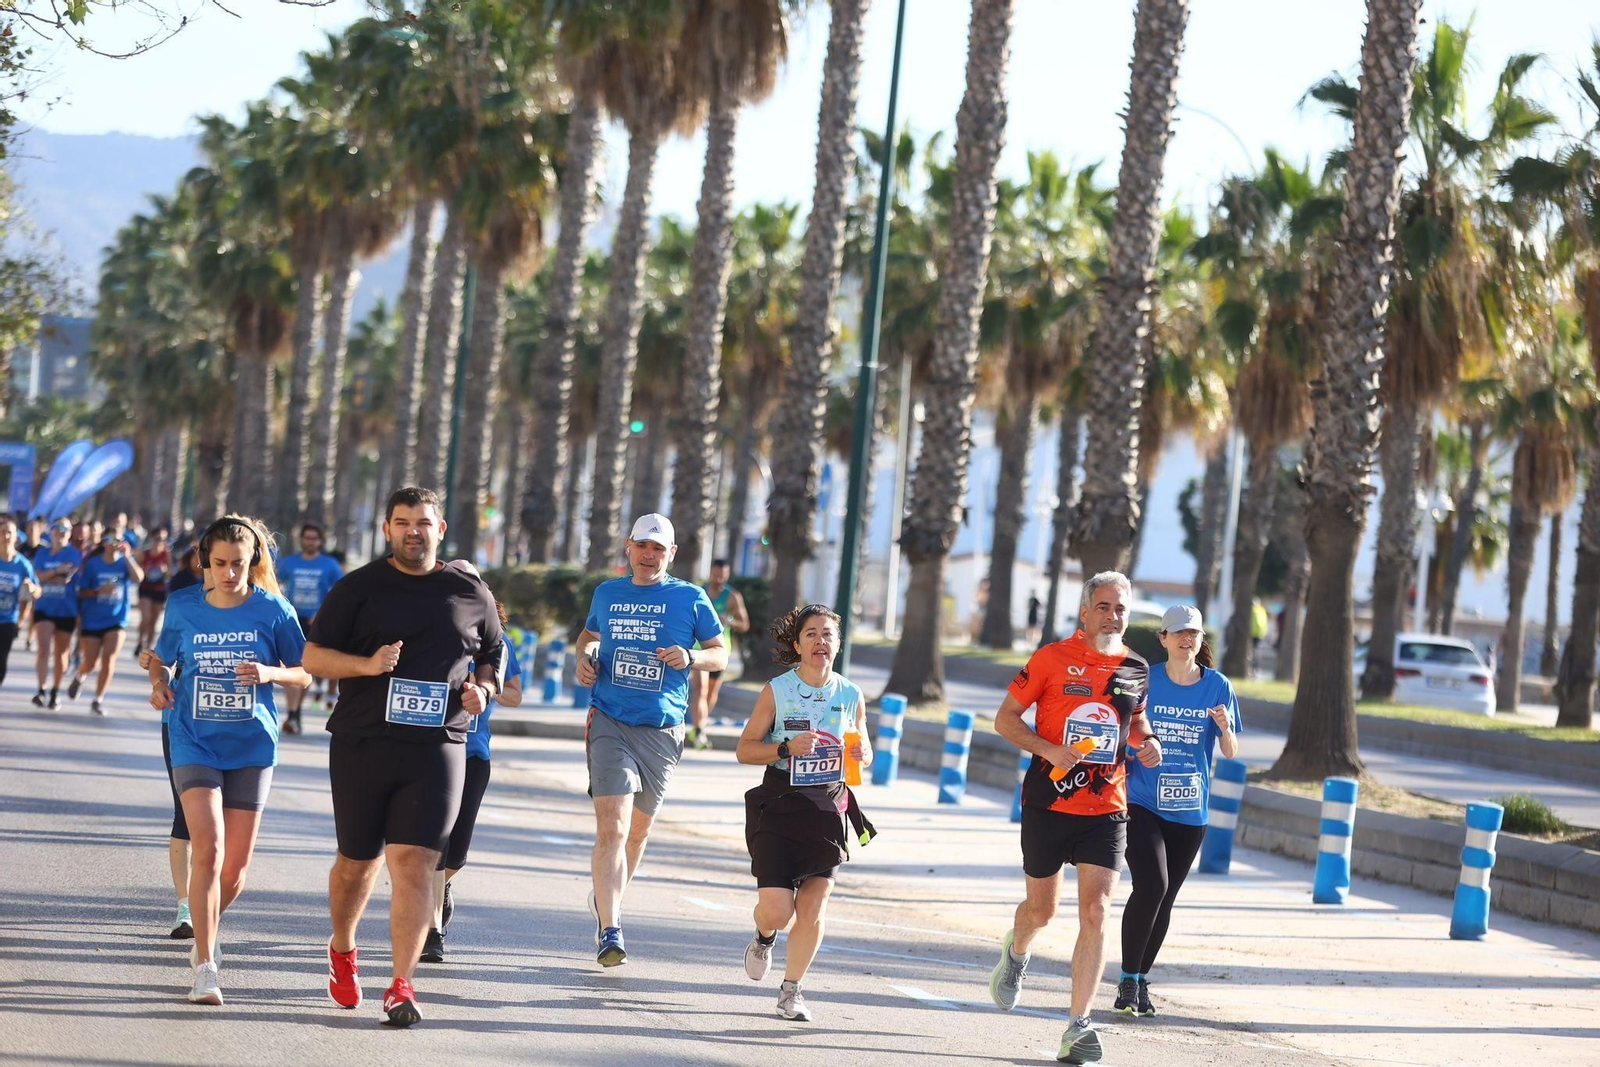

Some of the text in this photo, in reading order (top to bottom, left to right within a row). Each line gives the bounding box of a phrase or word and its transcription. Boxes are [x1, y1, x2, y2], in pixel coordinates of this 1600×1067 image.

[610, 603, 667, 615] mayoral
[608, 618, 661, 628] RUNNING
[612, 625, 656, 634] MAKES
[193, 629, 258, 646] mayoral
[611, 632, 657, 642] FRIENDS
[193, 650, 254, 660] RUNNING
[199, 666, 238, 675] FRIEN
[619, 663, 658, 679] 1643
[202, 694, 247, 708] 1821
[396, 696, 441, 712] 1879
[1153, 705, 1208, 718] mayoral
[1152, 720, 1204, 733] RUNNING
[1157, 728, 1199, 738] MAKES
[798, 759, 837, 773] 1707
[1163, 788, 1198, 798] 2009
